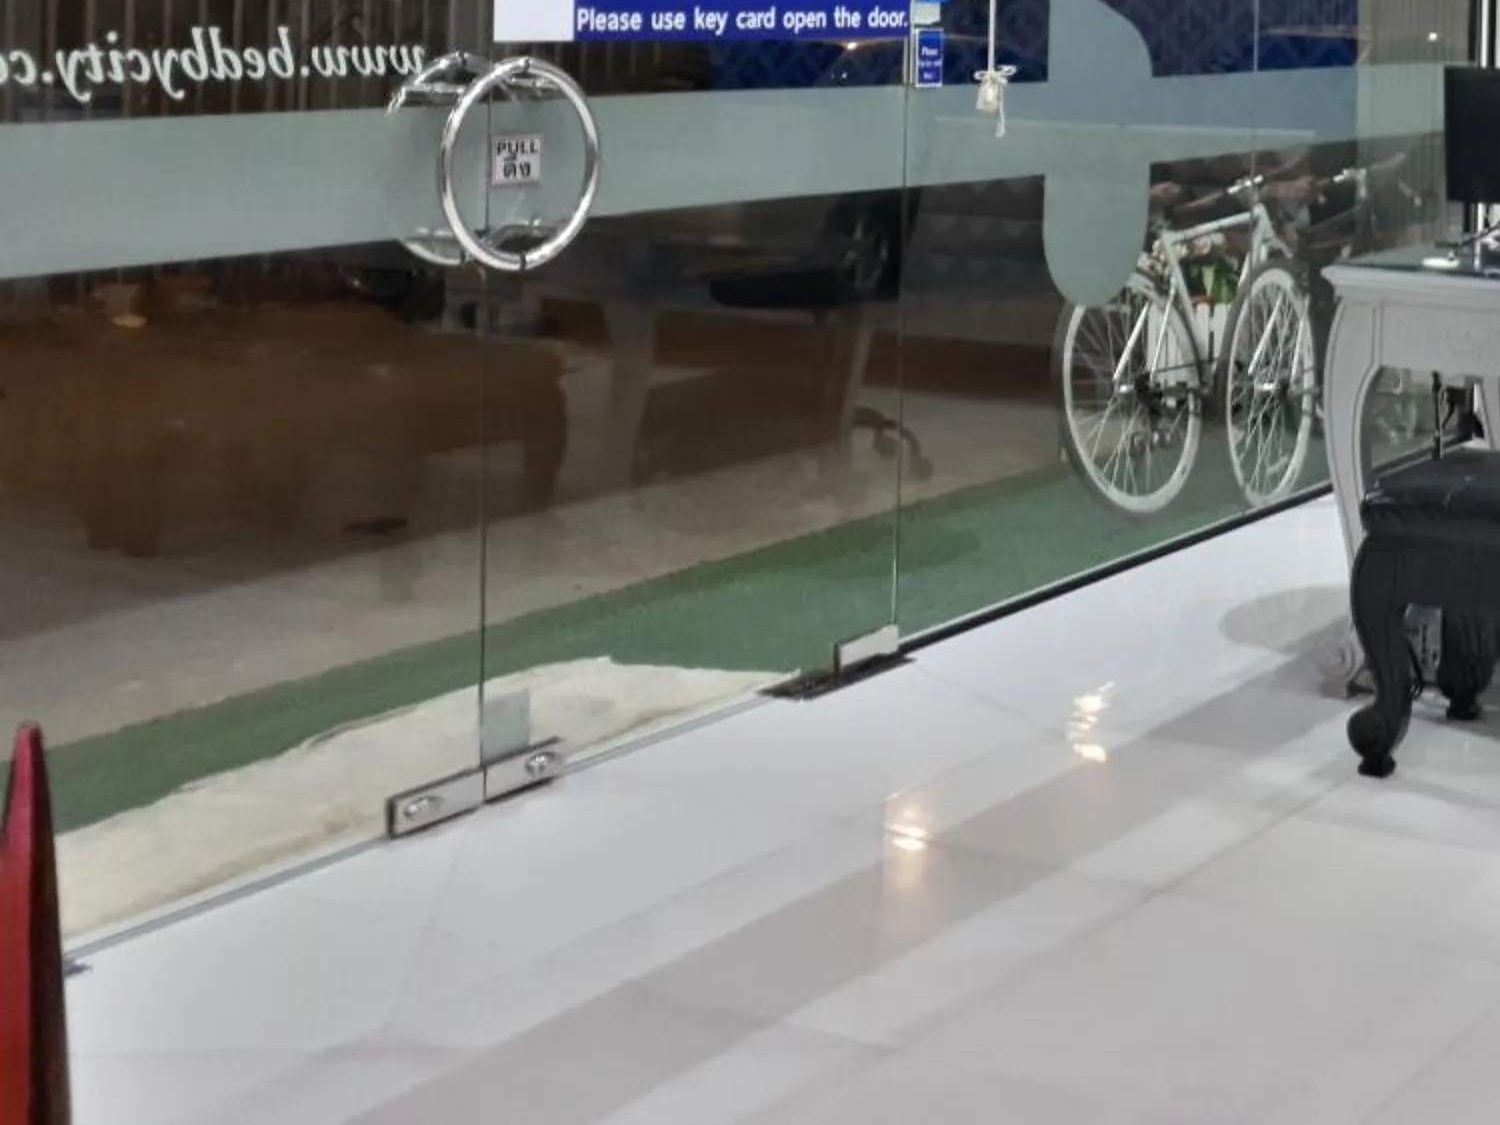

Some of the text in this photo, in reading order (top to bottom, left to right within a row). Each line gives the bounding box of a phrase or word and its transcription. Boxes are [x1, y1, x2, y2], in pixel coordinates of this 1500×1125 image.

[577, 5, 908, 36] Please use key card open the door.
[496, 138, 538, 156] PULL
